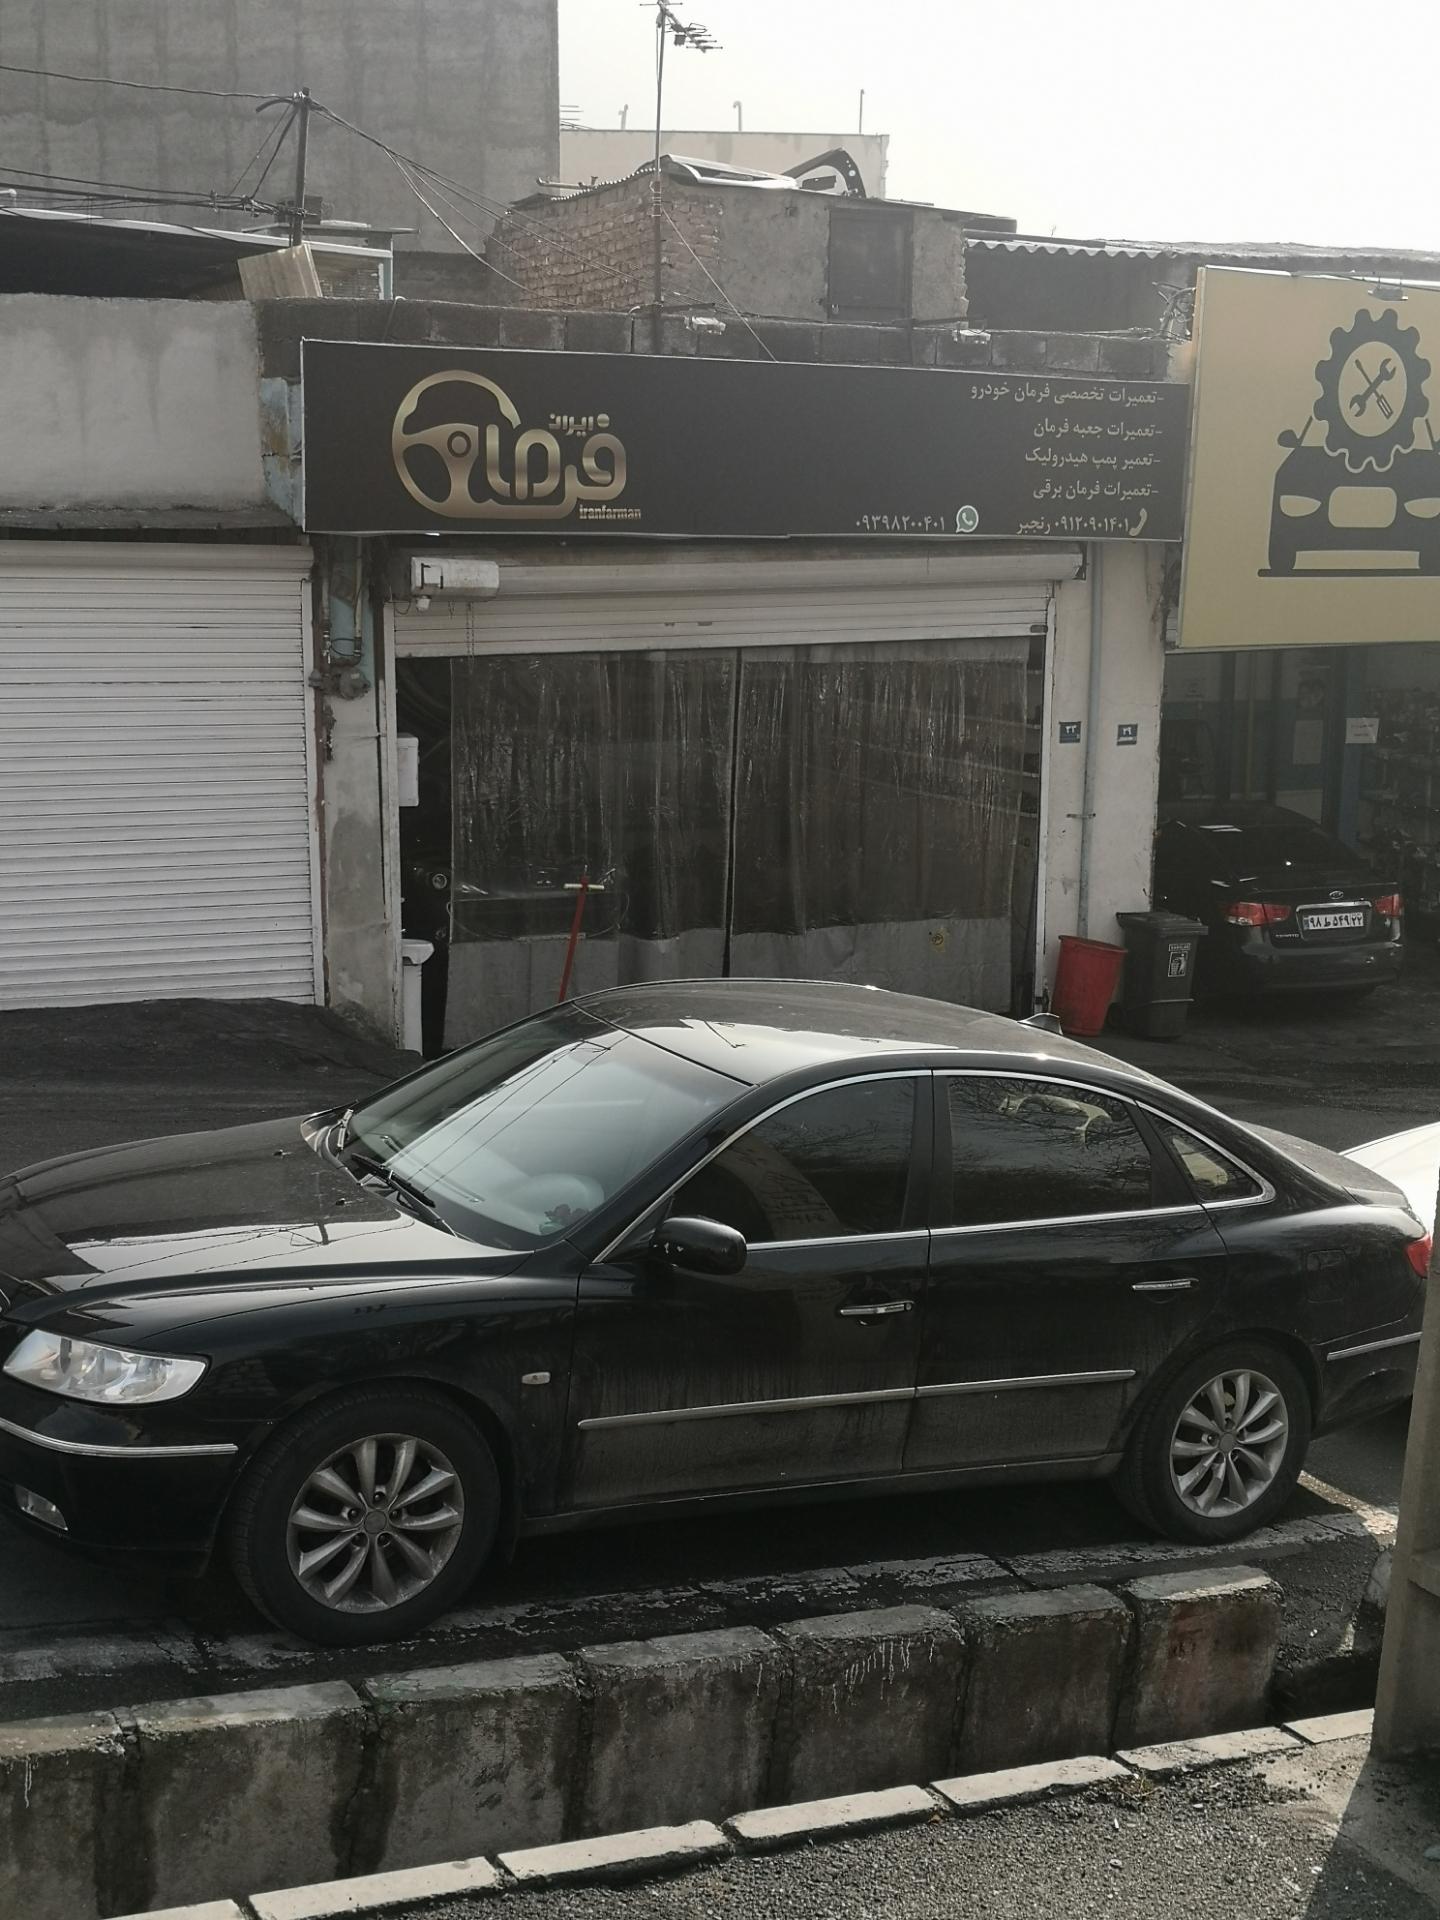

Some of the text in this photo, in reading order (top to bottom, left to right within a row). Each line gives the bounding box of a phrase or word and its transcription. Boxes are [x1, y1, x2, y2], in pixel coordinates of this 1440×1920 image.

[970, 382, 1010, 401] خودرو
[1014, 382, 1051, 402] فرمان
[1054, 386, 1105, 404] تخصصی
[549, 413, 594, 438] ایران
[1033, 417, 1070, 438] فرمان
[1073, 425, 1103, 440] جعبه
[1025, 447, 1089, 467] هیدرولیک
[1092, 455, 1117, 470] پمپ
[1033, 478, 1063, 499] برقی
[1065, 480, 1101, 499] فرمان
[579, 503, 641, 520] iranfarman
[1016, 515, 1051, 535] رنجبر
